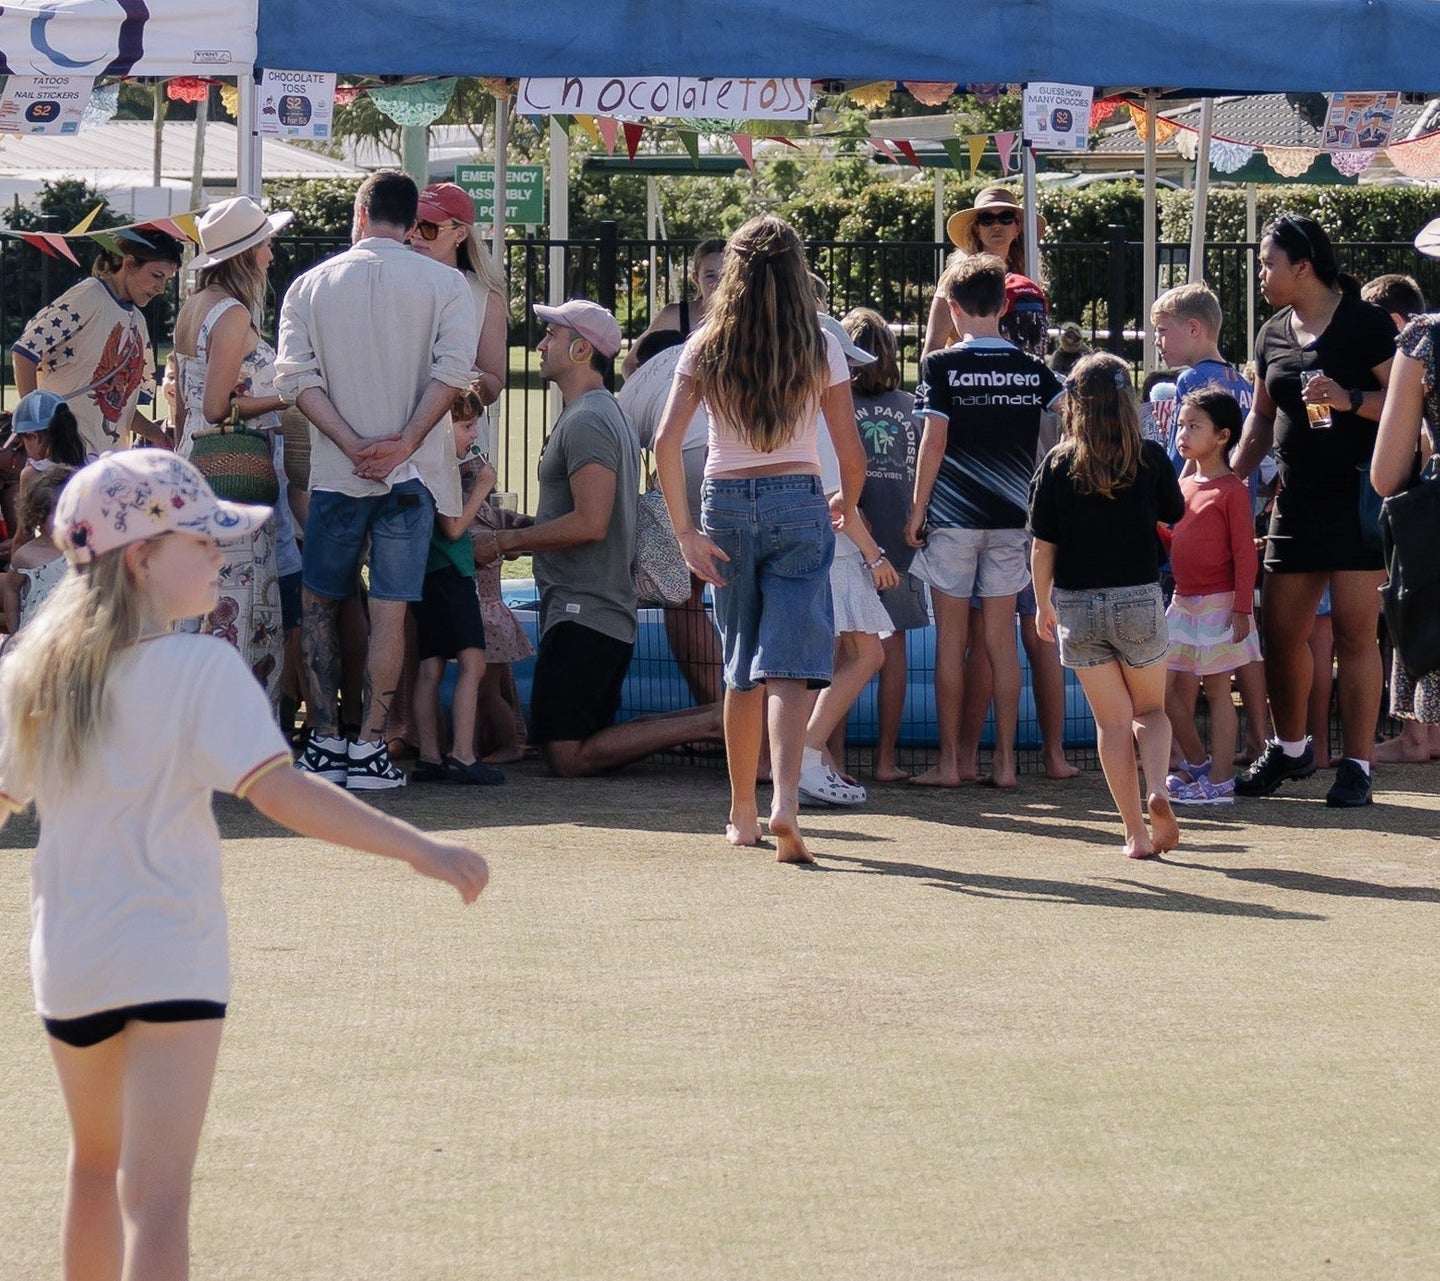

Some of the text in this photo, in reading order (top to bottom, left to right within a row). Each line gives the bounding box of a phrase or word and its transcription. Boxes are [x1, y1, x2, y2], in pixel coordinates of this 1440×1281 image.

[268, 71, 325, 84] CHOCOLATE
[14, 90, 80, 100] NAIL STICKERS
[282, 84, 307, 94] TOSS
[1038, 86, 1083, 98] GUESS HOW
[1028, 95, 1055, 104] MANY
[32, 104, 52, 117] $2
[461, 171, 538, 183] EMERENCY
[480, 206, 518, 217] PONT
[873, 405, 917, 465] PARADISE
